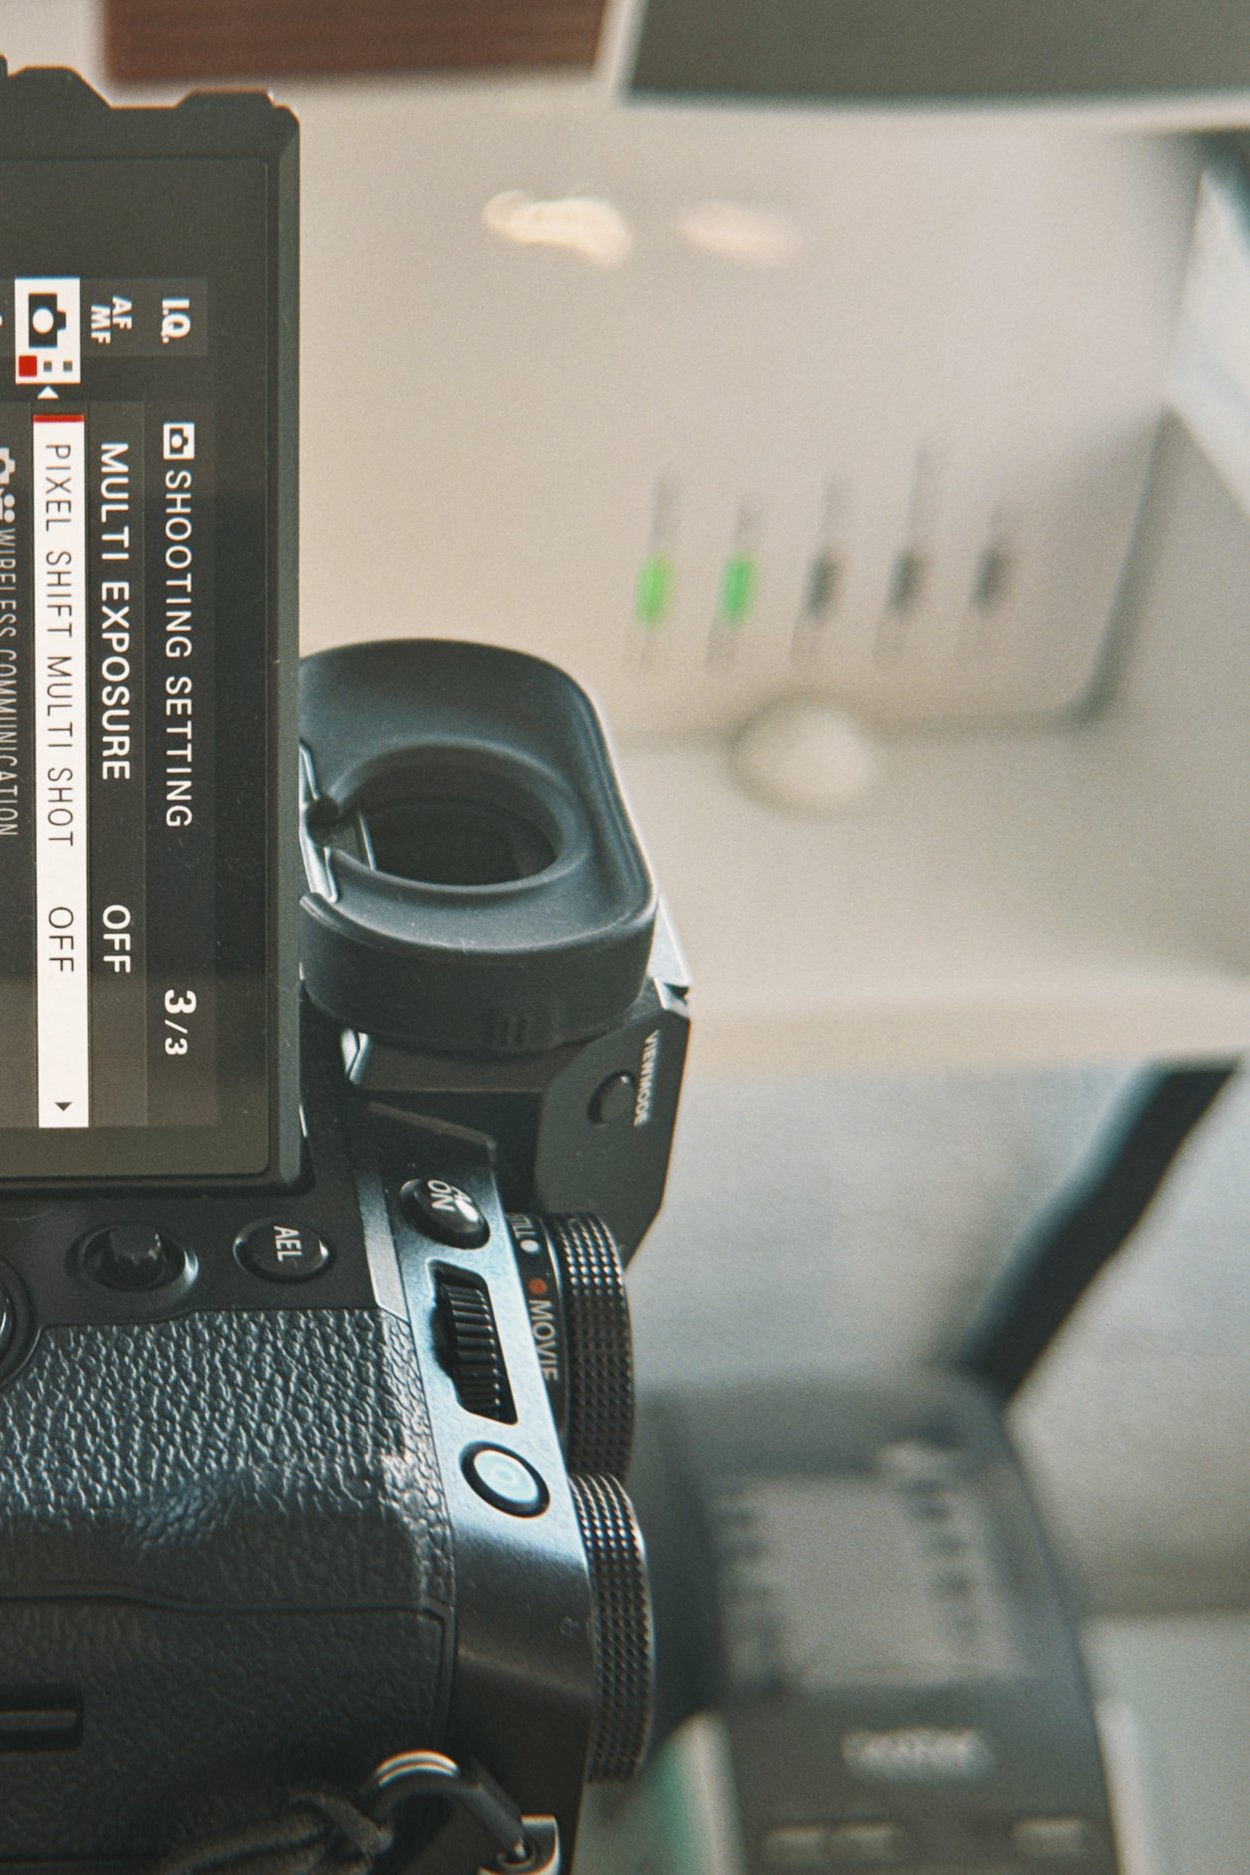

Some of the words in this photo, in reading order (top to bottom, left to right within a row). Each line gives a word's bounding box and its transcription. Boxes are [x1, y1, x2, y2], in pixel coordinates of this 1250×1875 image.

[90, 304, 110, 344] MF
[112, 295, 132, 330] AF
[45, 444, 72, 532] PIXEL
[100, 442, 129, 560] MULTI
[46, 550, 73, 638] SHIFT
[164, 469, 193, 658] SHOOTING
[46, 656, 74, 748] MULTI
[101, 581, 131, 780] EXPOSURE
[165, 675, 193, 827] SETTING
[47, 767, 74, 847] SHOT
[48, 906, 75, 973] OFF
[102, 904, 131, 974] OFF
[164, 989, 197, 1056] 3/3
[641, 1029, 659, 1075] VIEW
[633, 1075, 652, 1127] MODE
[427, 1180, 455, 1212] ON
[273, 1225, 303, 1262] AEL
[529, 1300, 560, 1382] MOVIE
